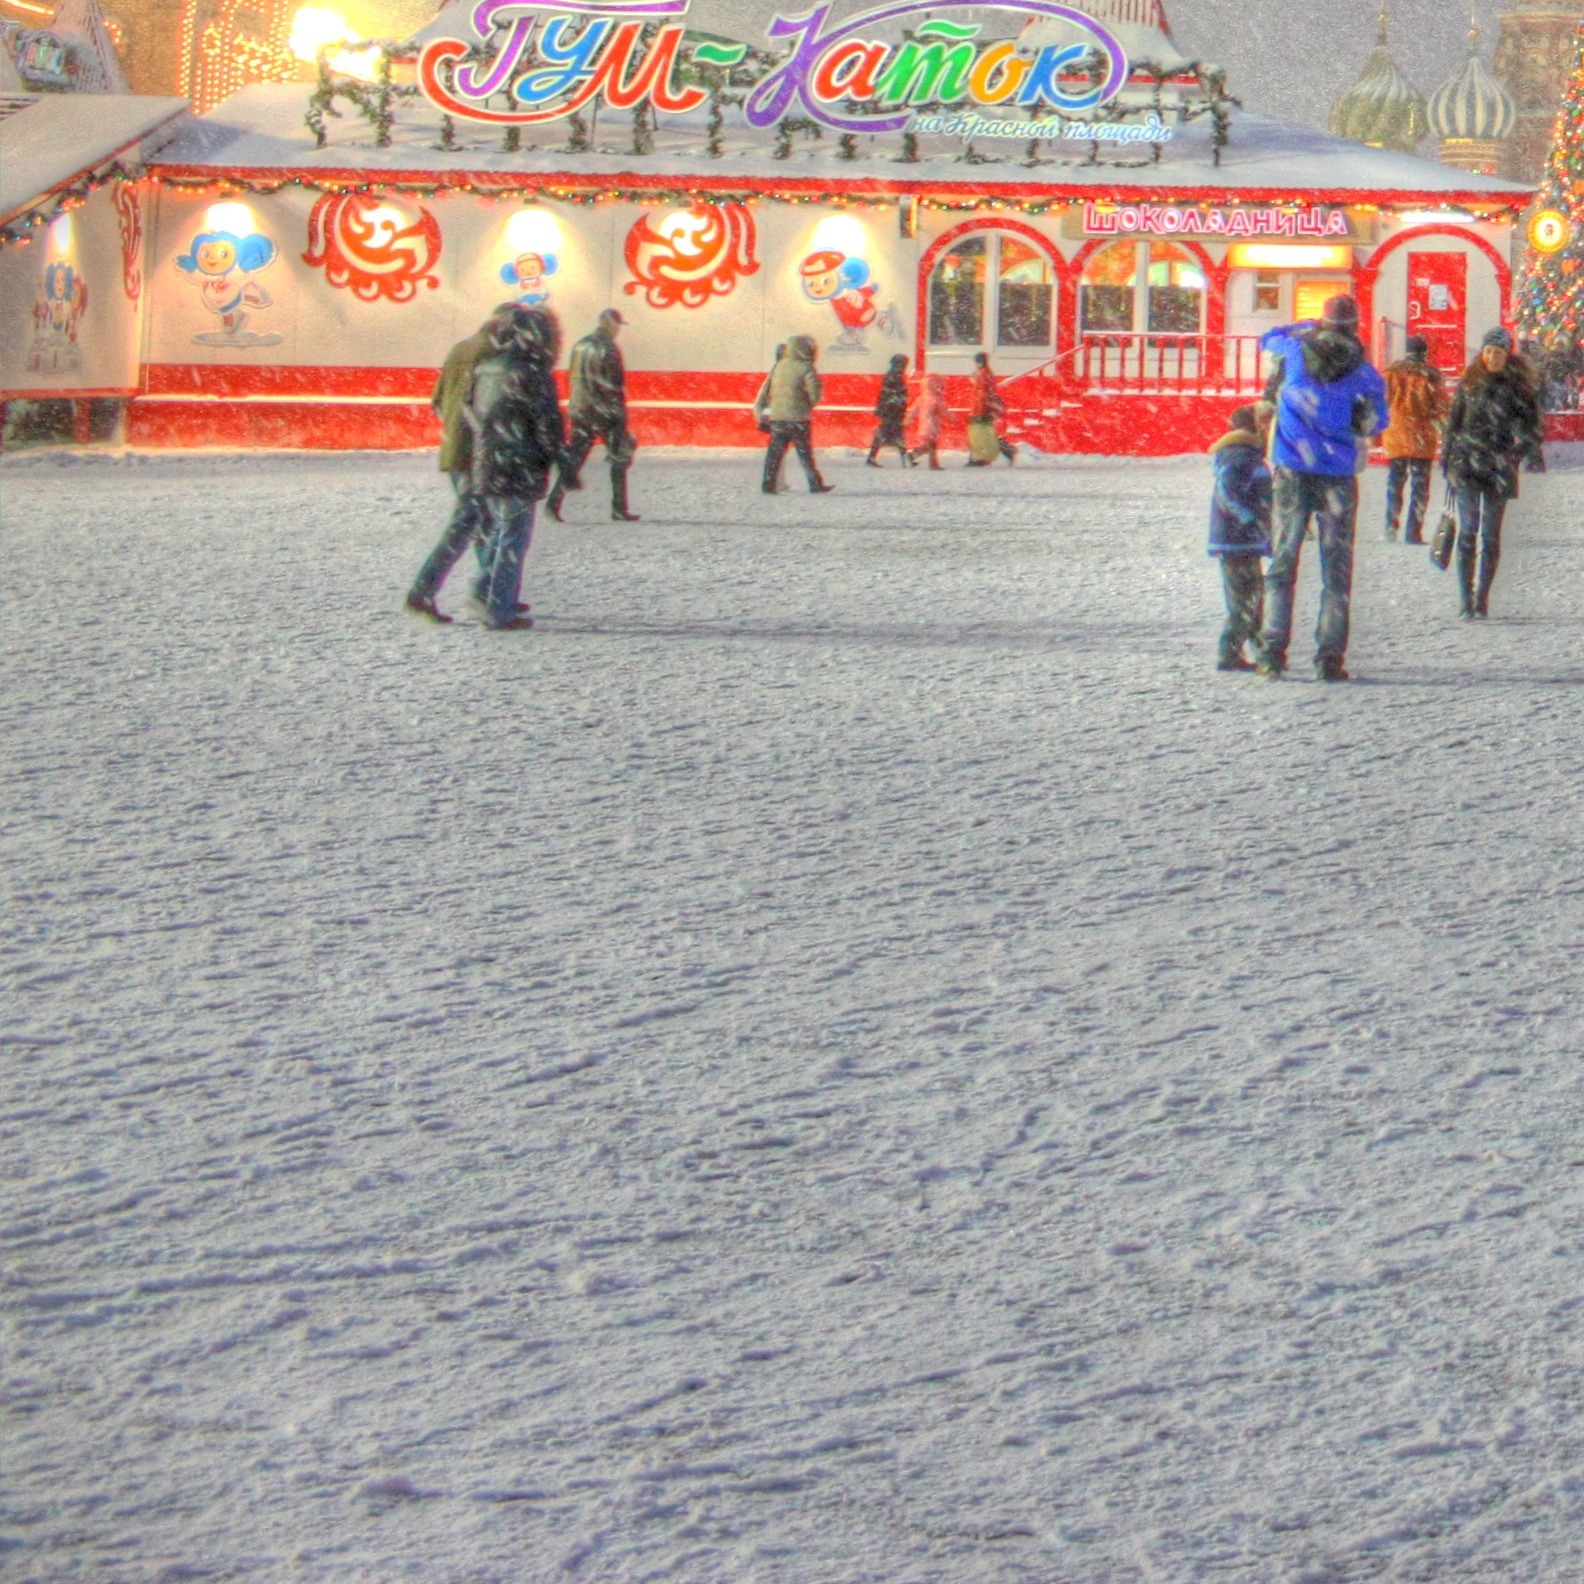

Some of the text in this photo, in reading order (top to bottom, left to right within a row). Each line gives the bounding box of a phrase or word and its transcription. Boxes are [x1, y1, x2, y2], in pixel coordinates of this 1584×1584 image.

[908, 112, 1173, 144] на Красной площади
[1083, 202, 1347, 236] ШОКОЛАДНИЦА
